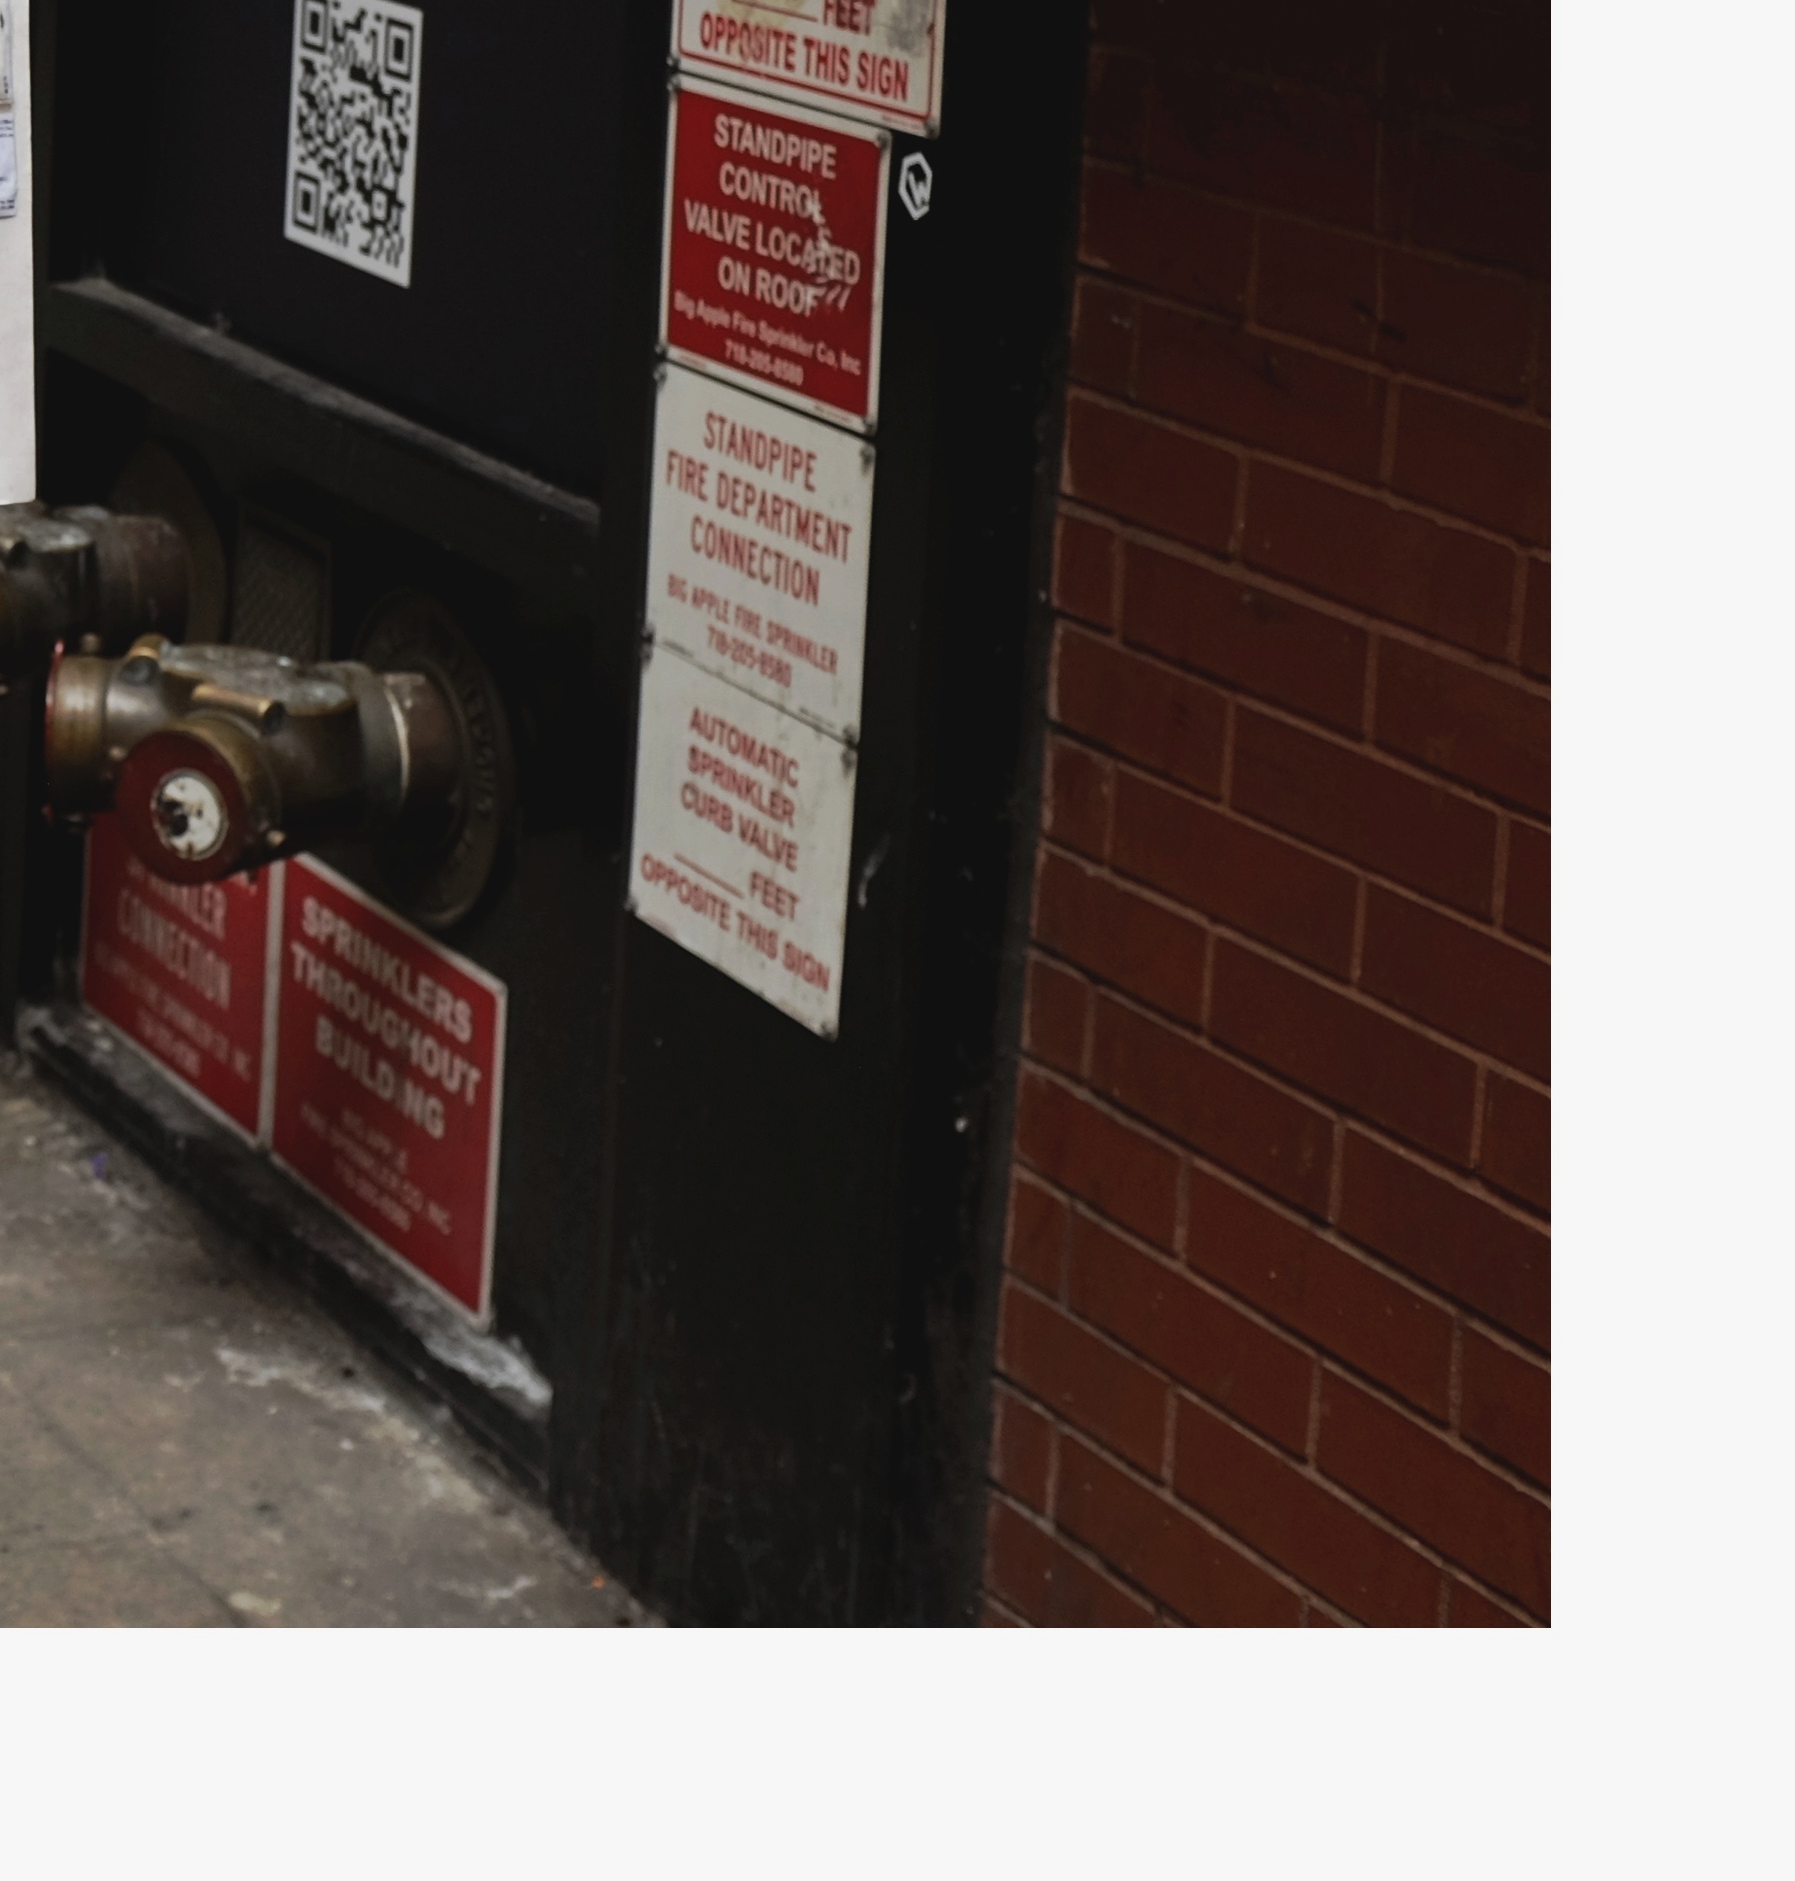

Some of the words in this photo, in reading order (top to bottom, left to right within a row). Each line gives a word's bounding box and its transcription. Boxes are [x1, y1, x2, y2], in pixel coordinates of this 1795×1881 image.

[700, 12, 797, 73] OPPOSITE
[803, 37, 851, 86] THIS
[856, 51, 909, 102] SIGN
[714, 113, 837, 181] STANDPIPE
[719, 161, 824, 224] CONTROL
[684, 198, 751, 250] VALVE
[756, 220, 861, 286] LOCATED
[717, 256, 751, 297] ON
[755, 268, 824, 317] ROOF
[703, 410, 818, 494] STANDPIPE
[665, 448, 709, 503] FIRE
[716, 472, 853, 565] DEPARTMENT
[690, 515, 821, 608] CONNECTION
[692, 587, 730, 624] APPLE
[766, 620, 838, 675] SPRINKLER
[688, 745, 796, 828] SPRINKLER
[689, 706, 799, 788] AUTOMATIC
[681, 781, 734, 833] CURB
[738, 814, 799, 873] VALVE
[640, 853, 731, 932] OPPOSITE
[736, 911, 779, 961] THIS
[782, 940, 830, 993] SIGN
[748, 870, 801, 921] FEET
[301, 896, 473, 1045] SPRINKLERS
[291, 941, 482, 1107] THROUGHOUT
[315, 1015, 445, 1140] BUILDING
